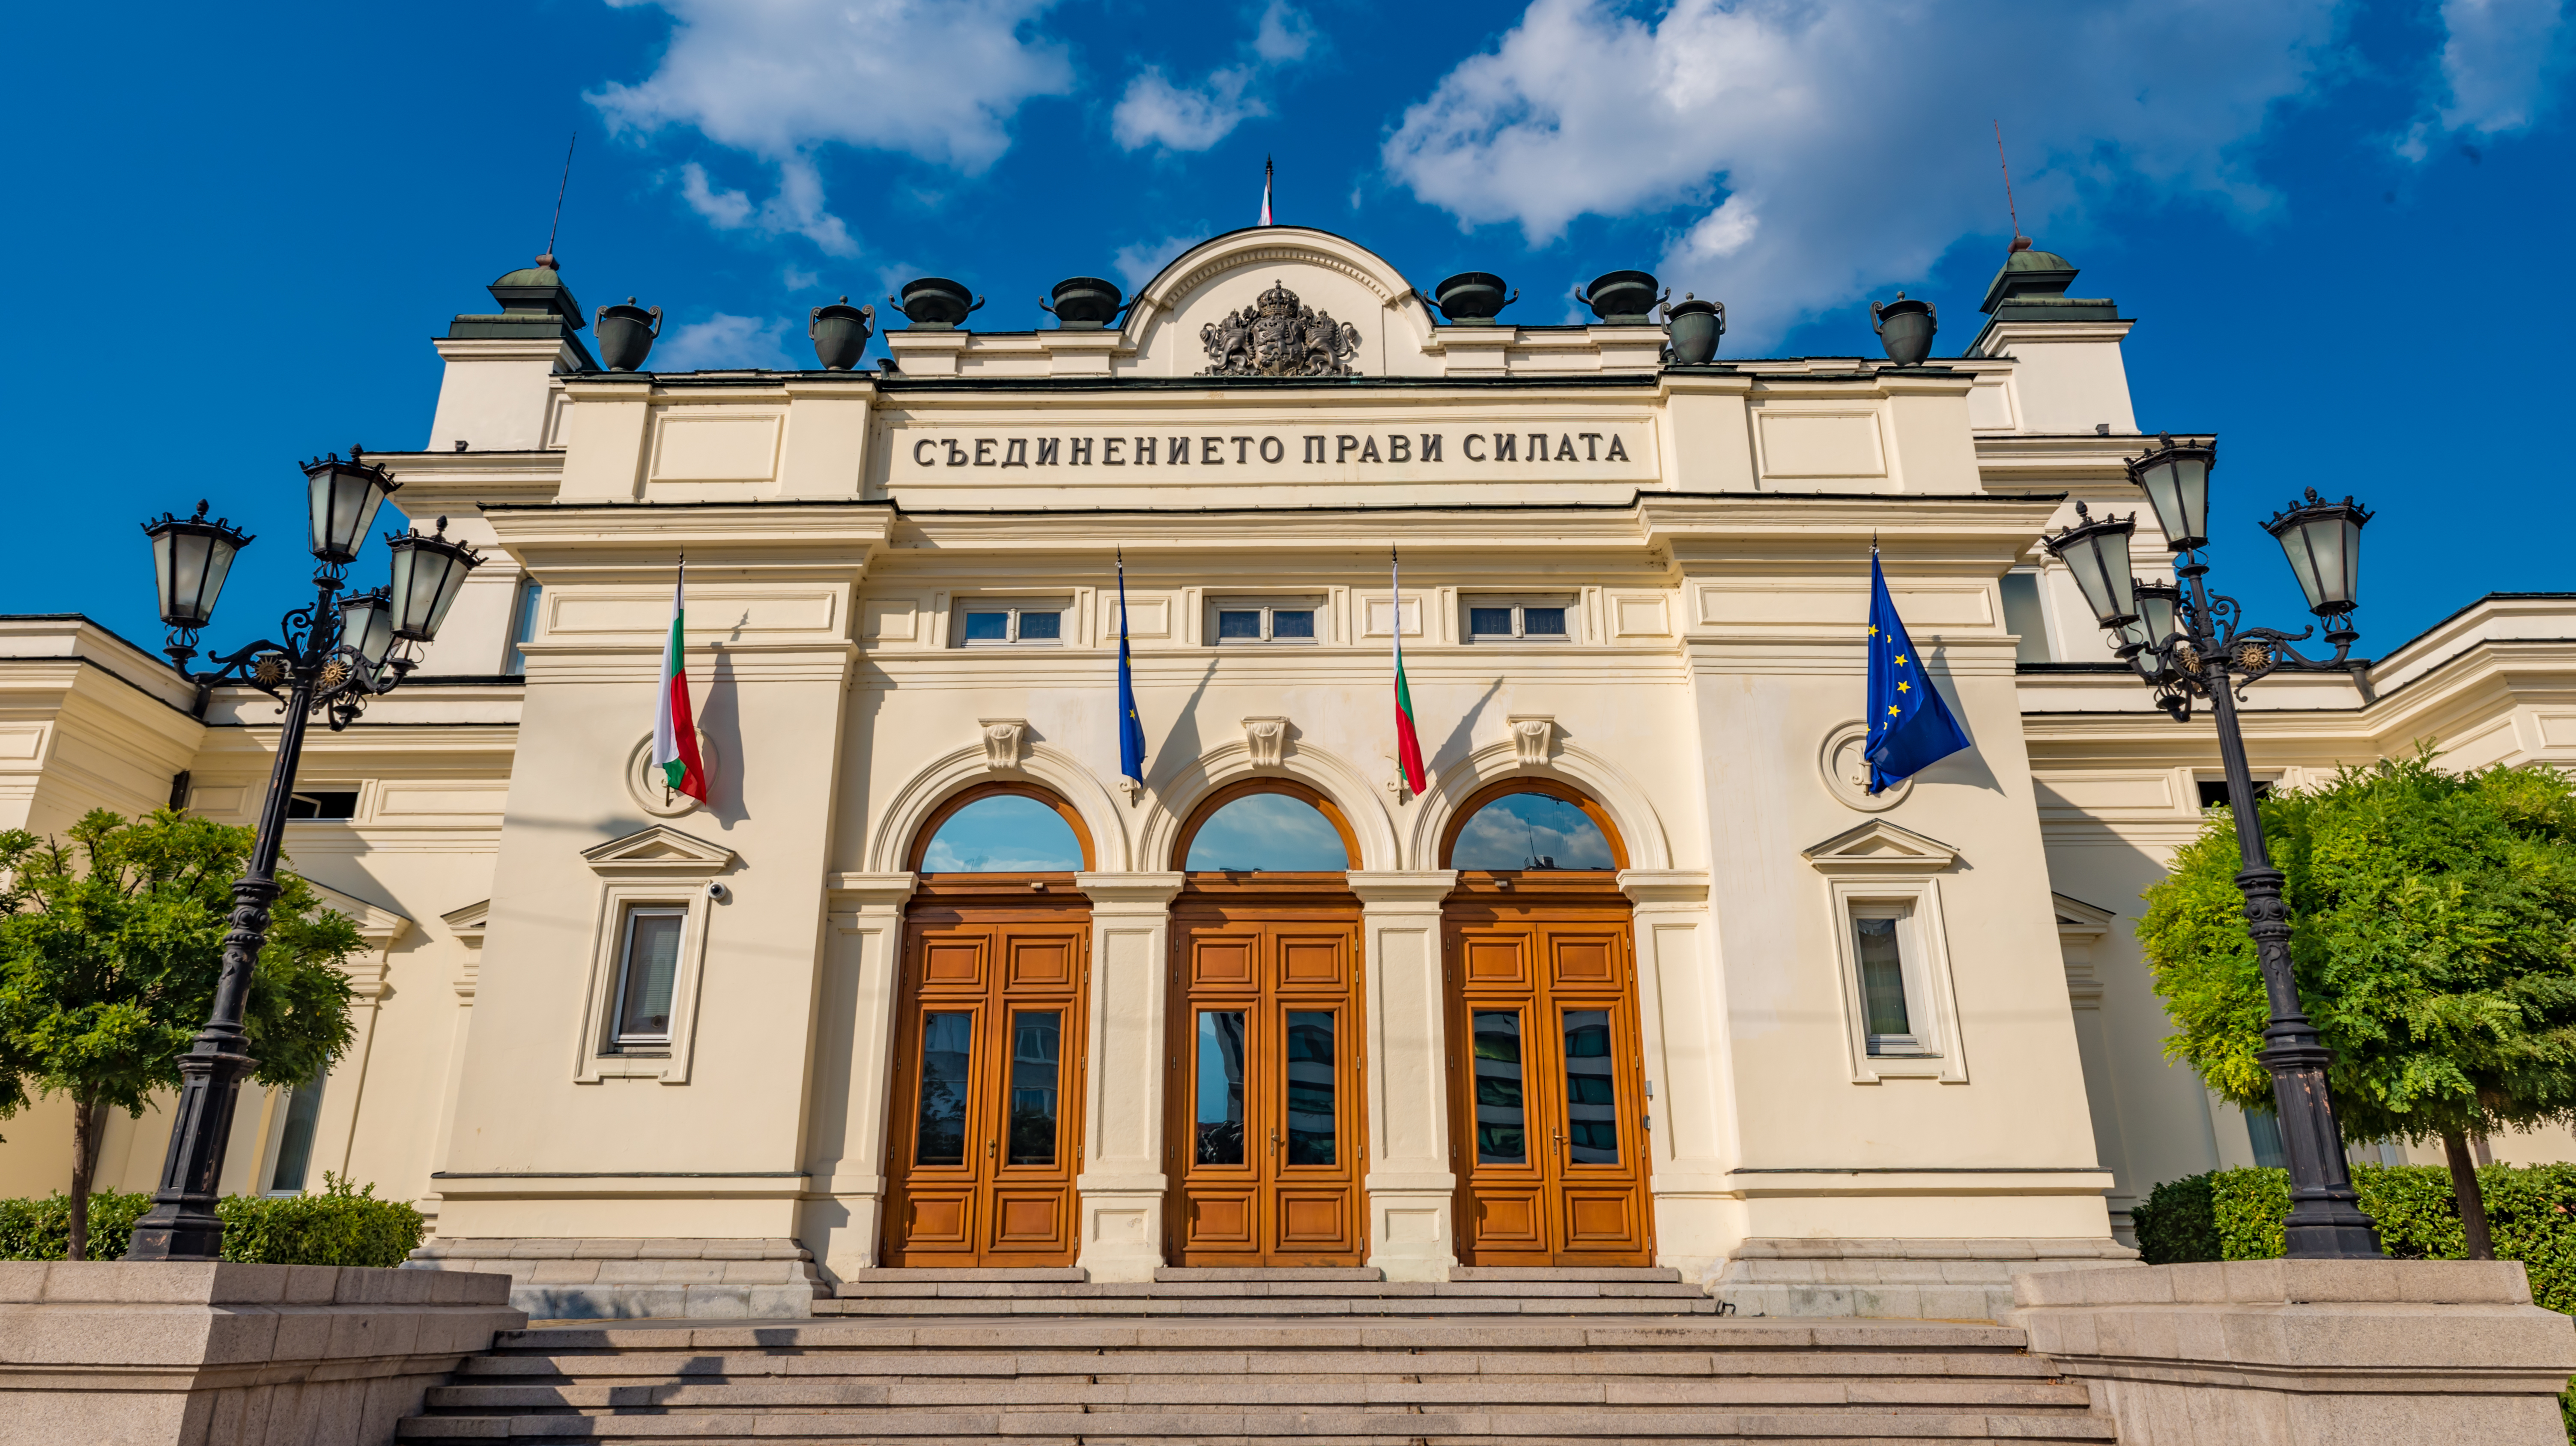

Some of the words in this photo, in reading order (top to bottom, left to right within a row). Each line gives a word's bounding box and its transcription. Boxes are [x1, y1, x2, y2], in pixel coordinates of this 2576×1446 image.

[913, 436, 1284, 468] СЪЕДИНЕНИЕТО
[1303, 434, 1442, 463] ПРАВИ
[1463, 433, 1629, 462] СИЛАТА
